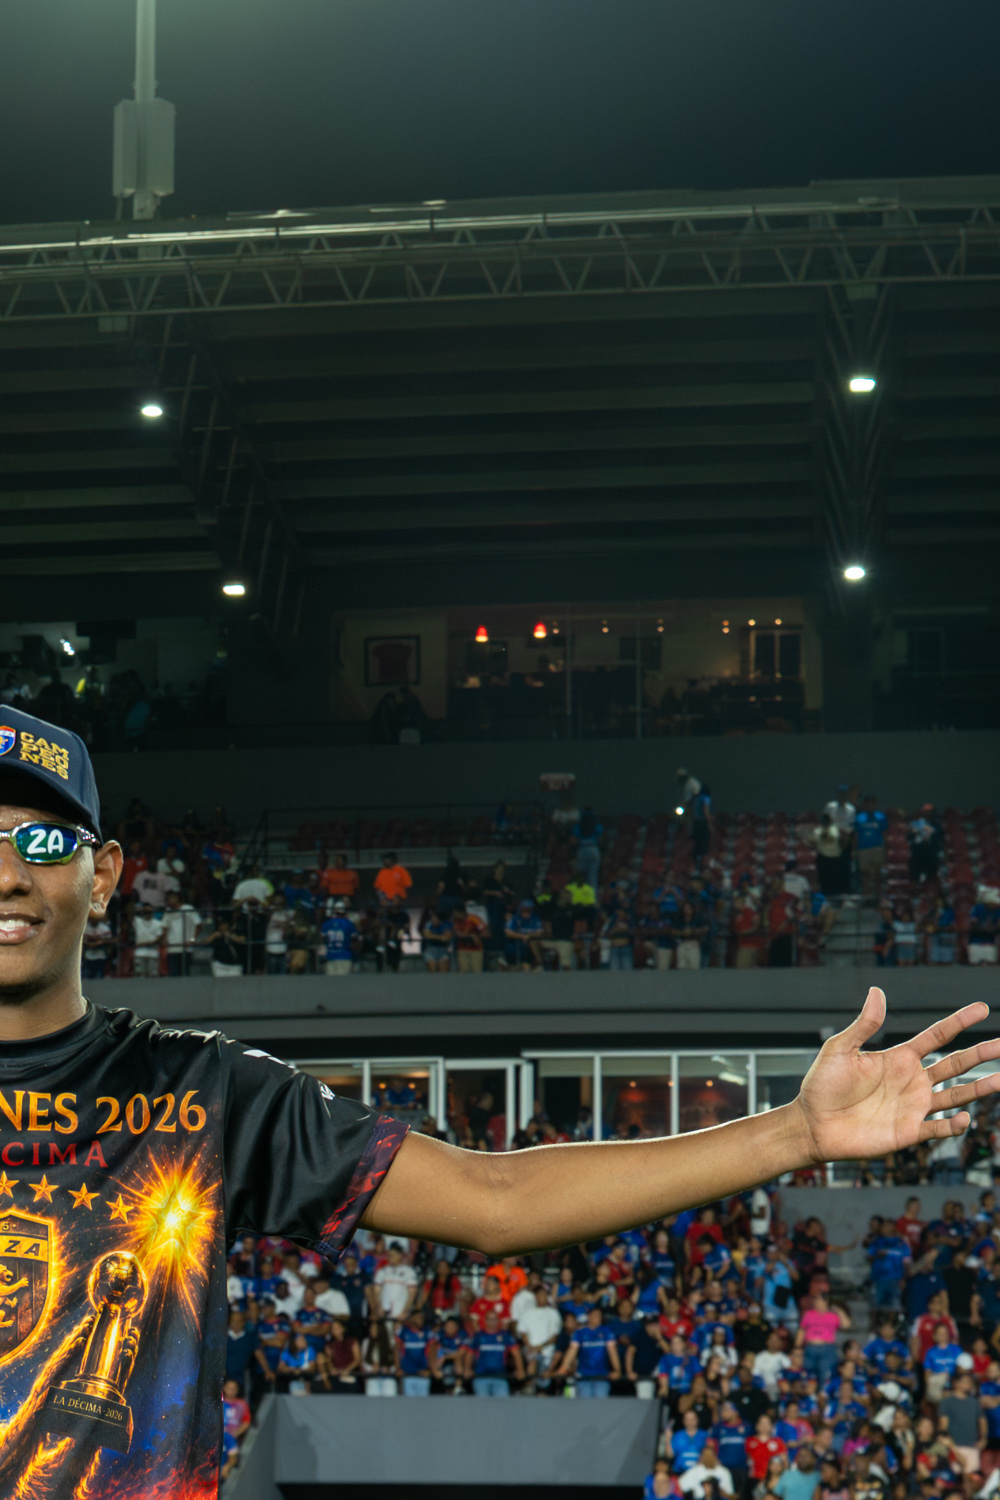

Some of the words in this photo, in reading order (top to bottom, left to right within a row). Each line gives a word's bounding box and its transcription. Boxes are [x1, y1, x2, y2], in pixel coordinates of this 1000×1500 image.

[20, 731, 70, 761] CAM
[20, 741, 69, 770] PEO
[19, 751, 69, 780] NES
[26, 829, 64, 855] ZA
[95, 1090, 207, 1135] 2026
[53, 1394, 66, 1406] LA
